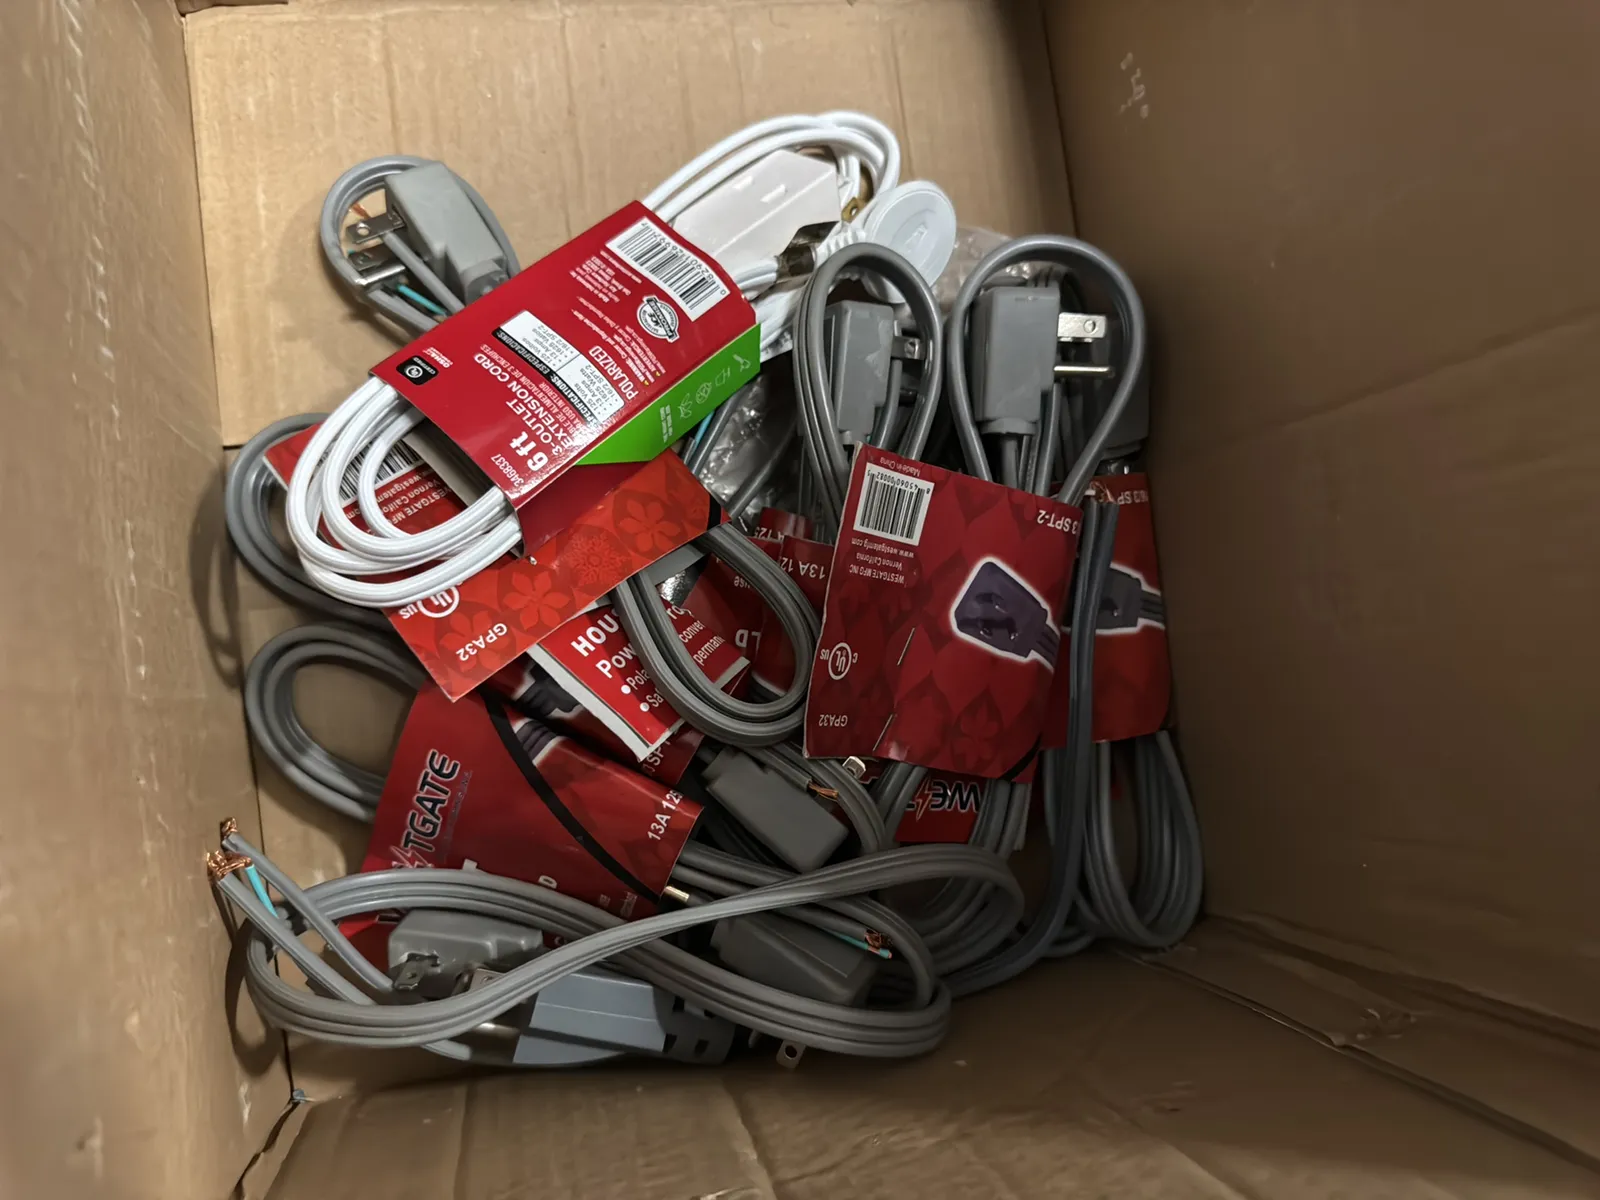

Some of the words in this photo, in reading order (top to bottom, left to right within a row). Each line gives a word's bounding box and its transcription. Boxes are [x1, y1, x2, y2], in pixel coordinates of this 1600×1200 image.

[646, 309, 663, 330] ACE
[648, 298, 674, 336] PROMISE
[472, 350, 511, 383] CORD
[510, 368, 523, 379] DE
[587, 344, 639, 399] POLARIZED
[537, 380, 566, 408] INTERIOR
[572, 382, 589, 399] Volts
[560, 404, 577, 420] USO
[585, 397, 599, 411] 125
[506, 378, 574, 448] EXTENSION
[554, 411, 567, 422] DE
[505, 395, 563, 456] 3-OUTLET
[507, 430, 537, 459] ft
[490, 451, 524, 487] 3468337
[524, 450, 550, 473] 6
[879, 456, 896, 469] China
[895, 462, 902, 471] in
[875, 471, 895, 483] 00082
[901, 464, 921, 476] Made
[895, 478, 918, 491] 45060
[385, 510, 405, 526] MF
[1035, 508, 1072, 532] SPT-2
[850, 535, 914, 558] www.westgatemfg.com
[777, 556, 795, 572] 12
[855, 551, 882, 565] California
[881, 558, 903, 570] Vernon
[795, 560, 827, 580] 13A
[848, 563, 859, 573] INC
[859, 566, 871, 576] MFG
[871, 569, 904, 583] WESTGATE
[397, 602, 418, 621] US
[454, 620, 508, 663] GPA32
[819, 648, 829, 659] US
[818, 714, 848, 726] GPA32
[645, 808, 671, 843] 13A
